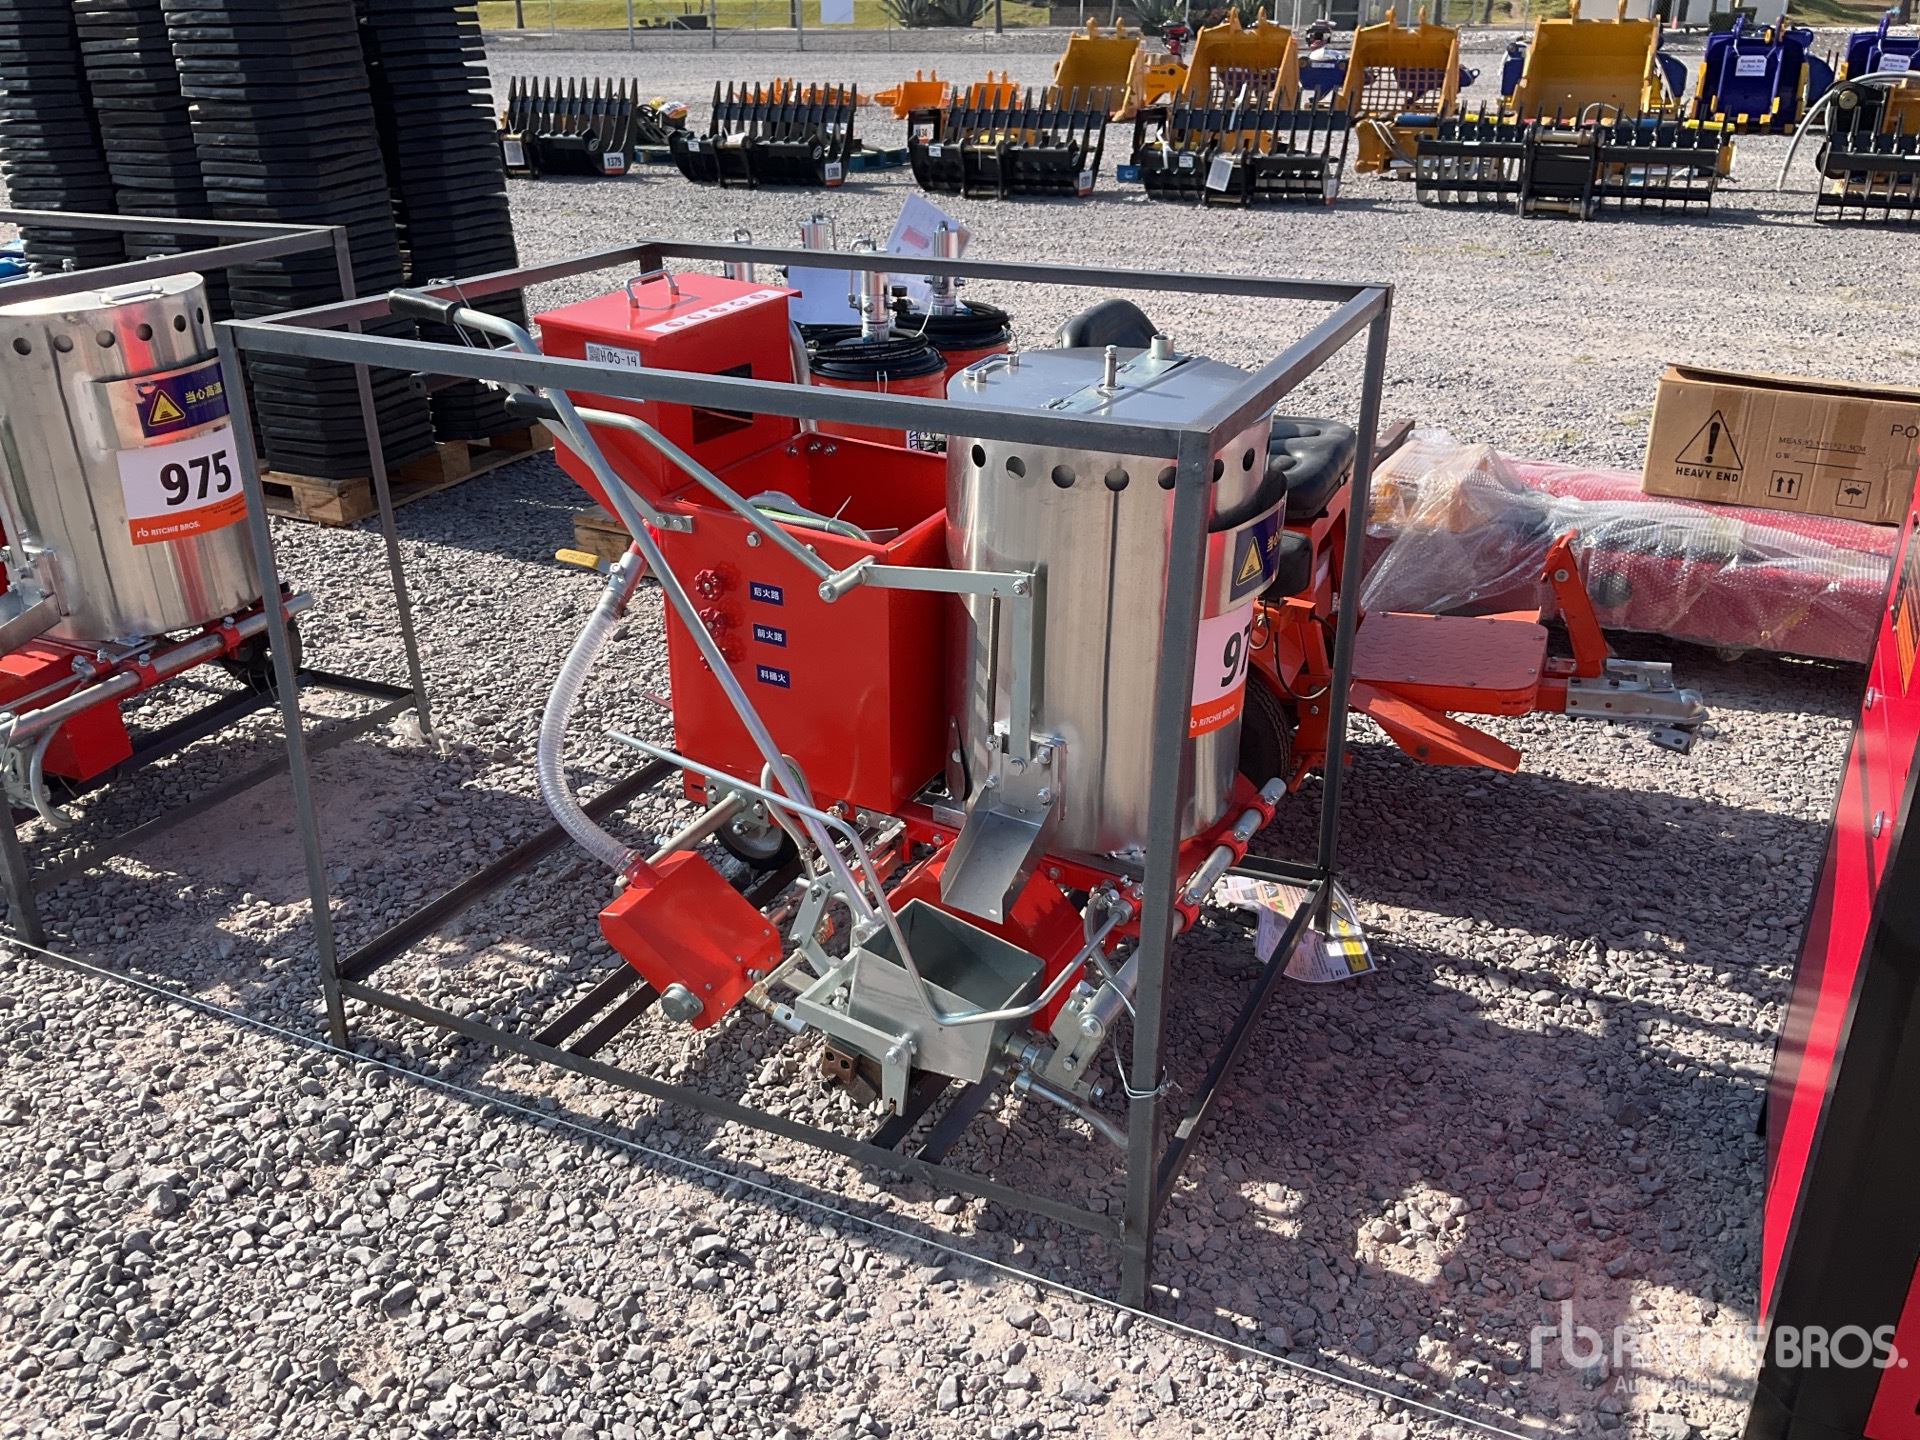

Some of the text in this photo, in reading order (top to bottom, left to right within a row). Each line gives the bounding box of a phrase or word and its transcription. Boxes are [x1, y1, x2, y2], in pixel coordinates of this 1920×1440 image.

[606, 156, 622, 167] 1379
[185, 382, 222, 404] 当心高温
[160, 450, 231, 505] 975
[1675, 466, 1739, 483] HEAVY END
[137, 527, 149, 537] rb
[151, 525, 178, 535] RITCHIE
[754, 587, 779, 600] 后火路
[757, 628, 783, 642] 前火路
[1198, 711, 1223, 727] RITCHIE
